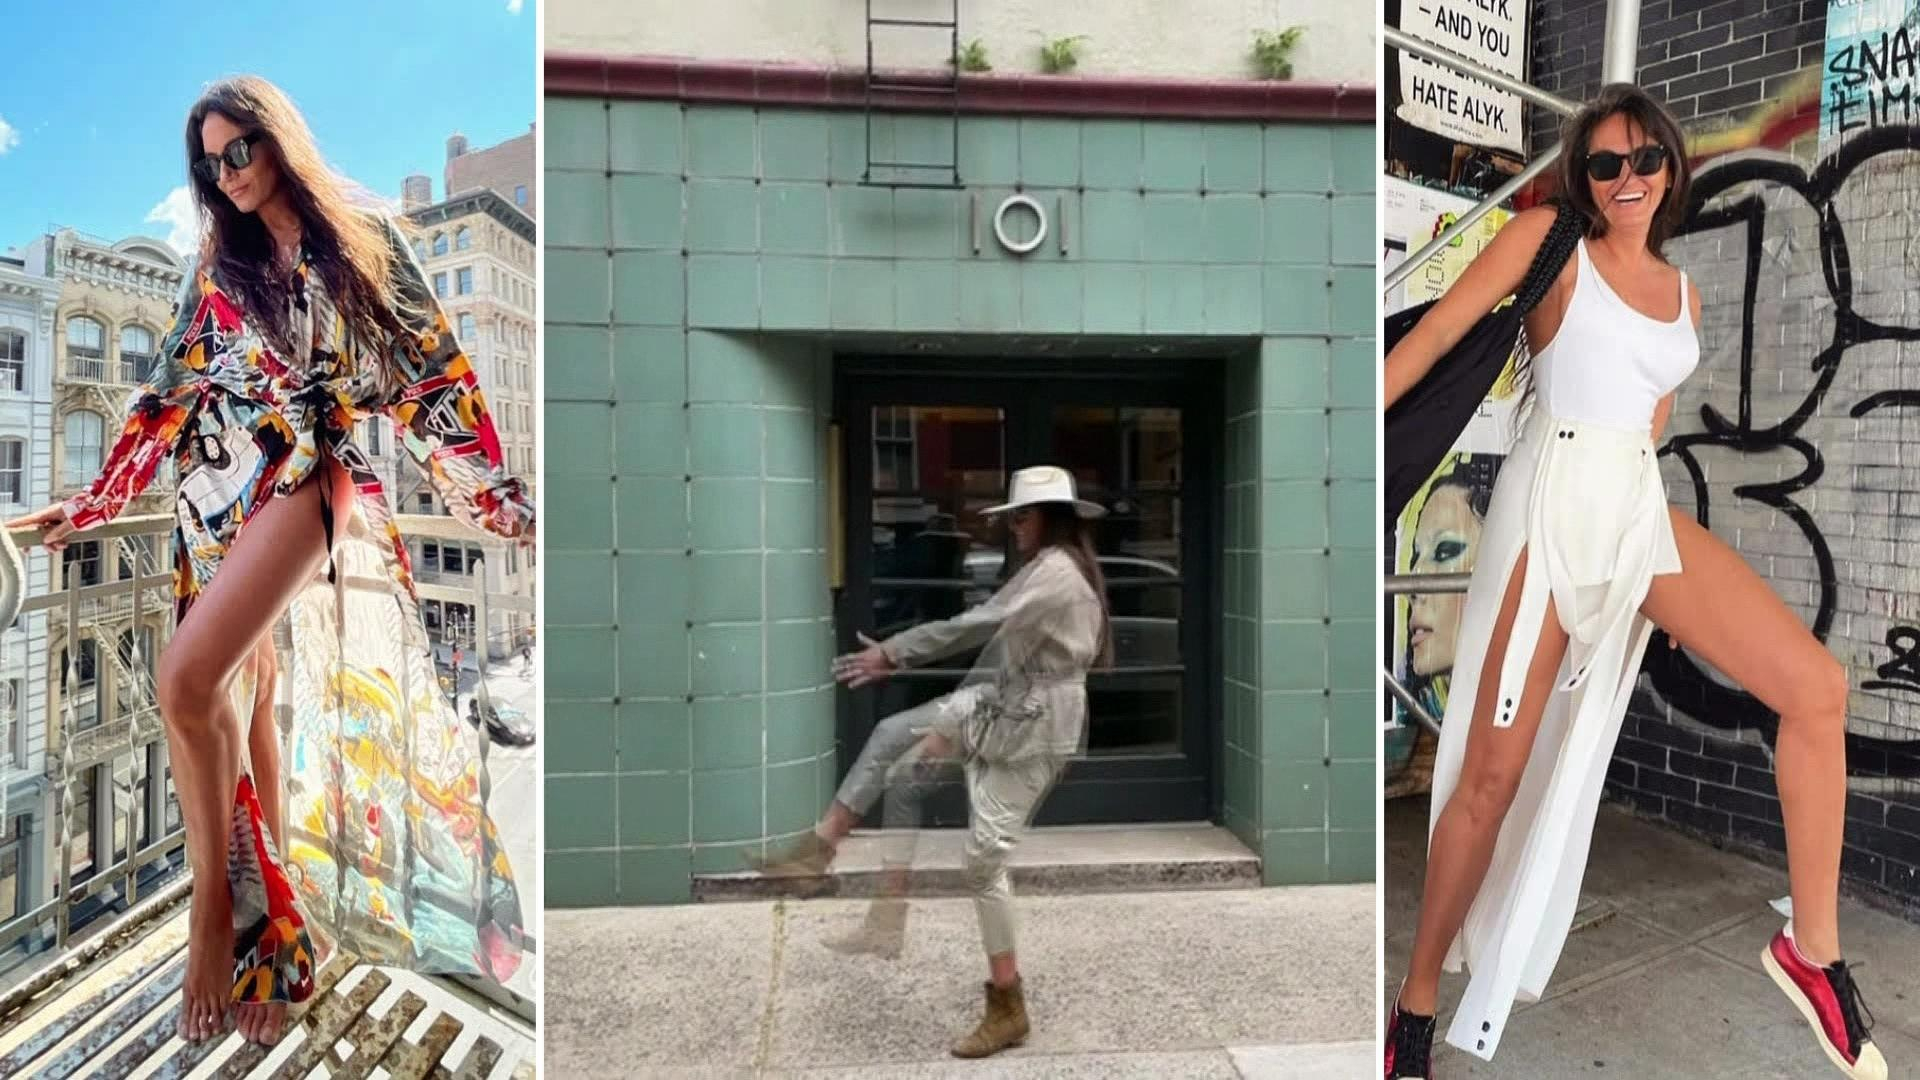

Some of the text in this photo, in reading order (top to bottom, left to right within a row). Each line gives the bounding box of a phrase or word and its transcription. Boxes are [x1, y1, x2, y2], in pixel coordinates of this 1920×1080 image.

[1435, 5, 1472, 41] AND
[1477, 21, 1510, 58] YOU
[1829, 26, 1920, 87] SNA
[1413, 75, 1458, 115] HATE
[1462, 96, 1508, 133] ALYK.
